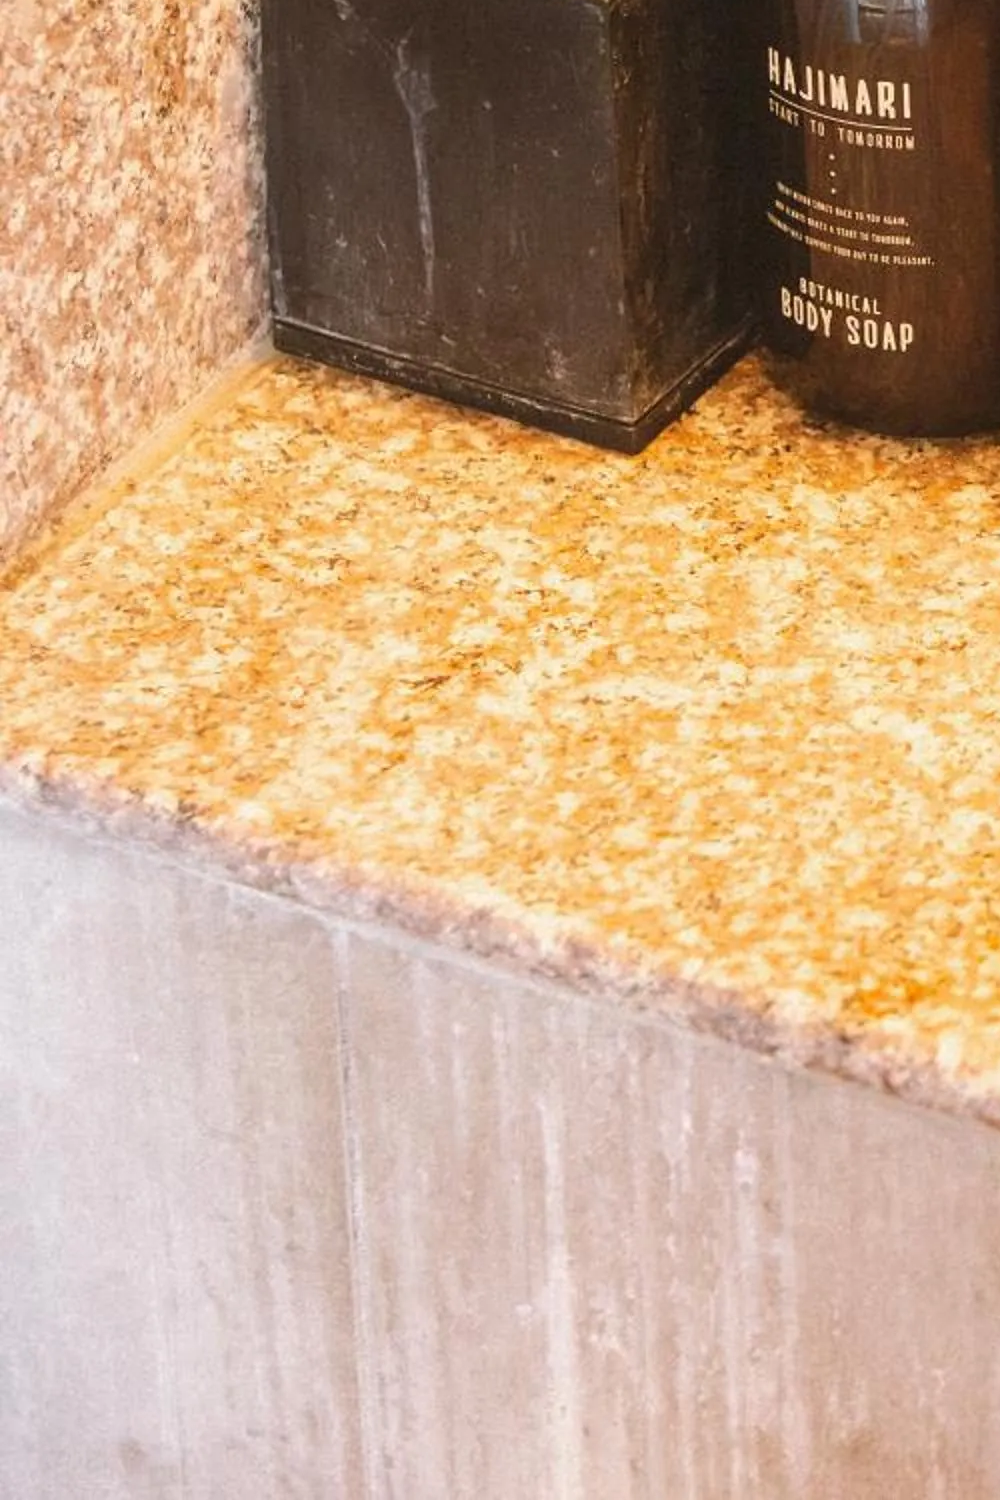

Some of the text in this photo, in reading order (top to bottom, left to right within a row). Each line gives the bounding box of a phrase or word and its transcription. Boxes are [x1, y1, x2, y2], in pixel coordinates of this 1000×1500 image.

[768, 47, 912, 119] HAJIMARI
[769, 97, 915, 150] START TO TOMORROW
[781, 286, 914, 352] BODY SOAP
[800, 277, 882, 315] BOTANICAL
